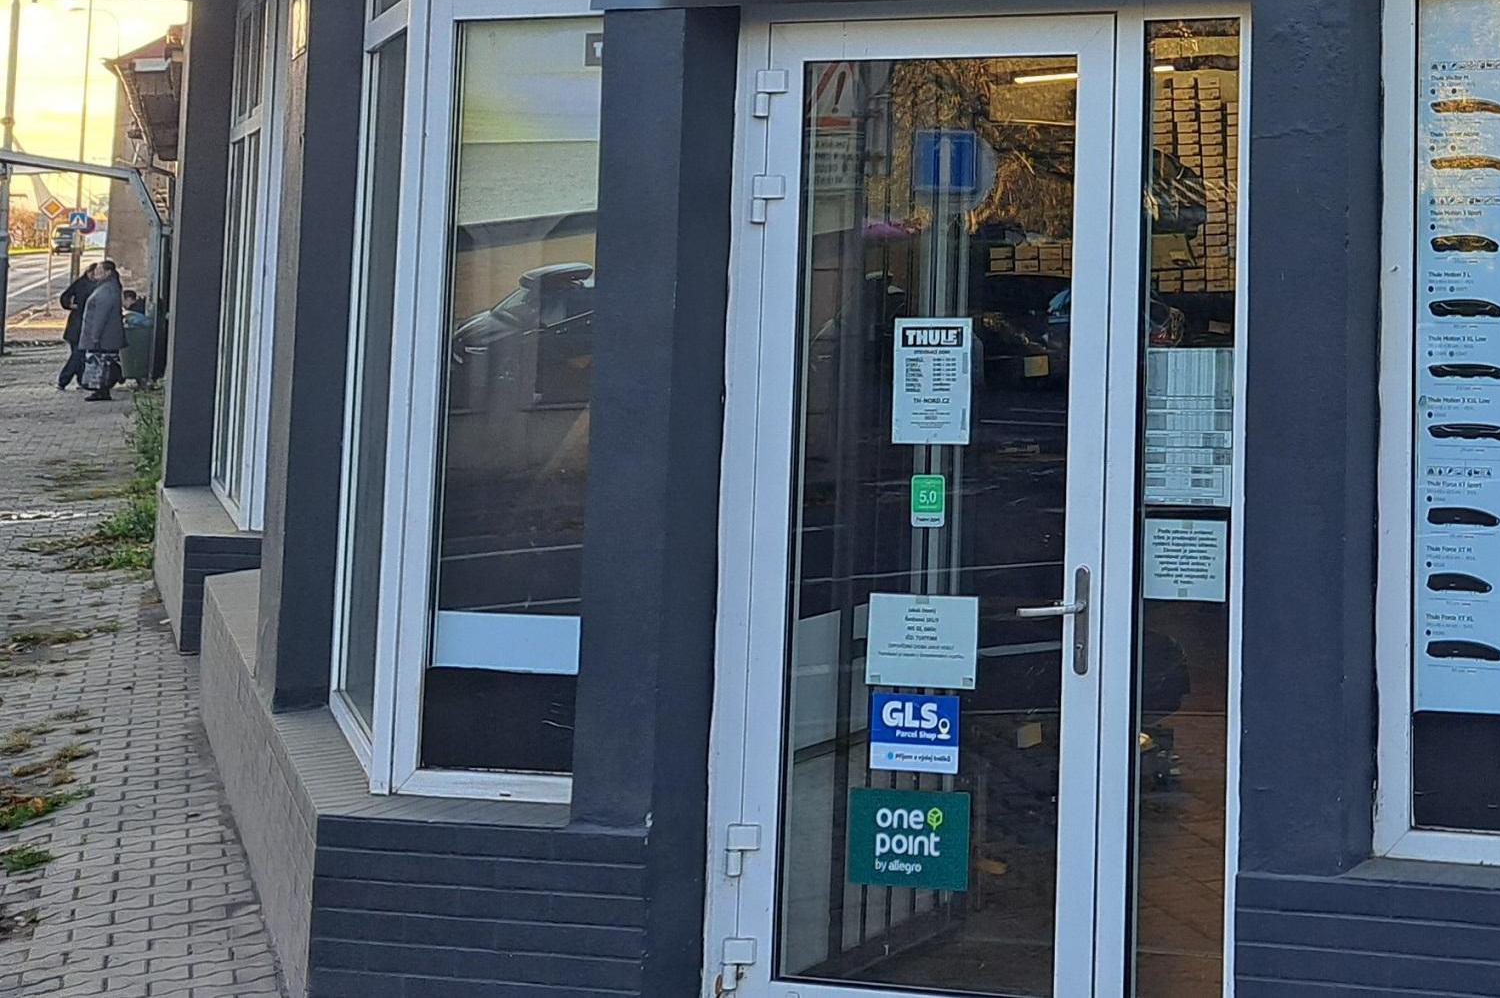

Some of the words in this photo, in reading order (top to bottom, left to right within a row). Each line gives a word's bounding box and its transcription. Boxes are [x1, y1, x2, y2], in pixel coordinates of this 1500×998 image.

[905, 329, 958, 345] THULE
[919, 490, 937, 504] 5,0
[882, 700, 939, 730] GLS
[895, 729, 918, 739] Parcel
[919, 731, 937, 741] Shop
[876, 807, 925, 830] one
[875, 831, 941, 857] point
[875, 857, 887, 874] by
[888, 858, 922, 875] allegro
